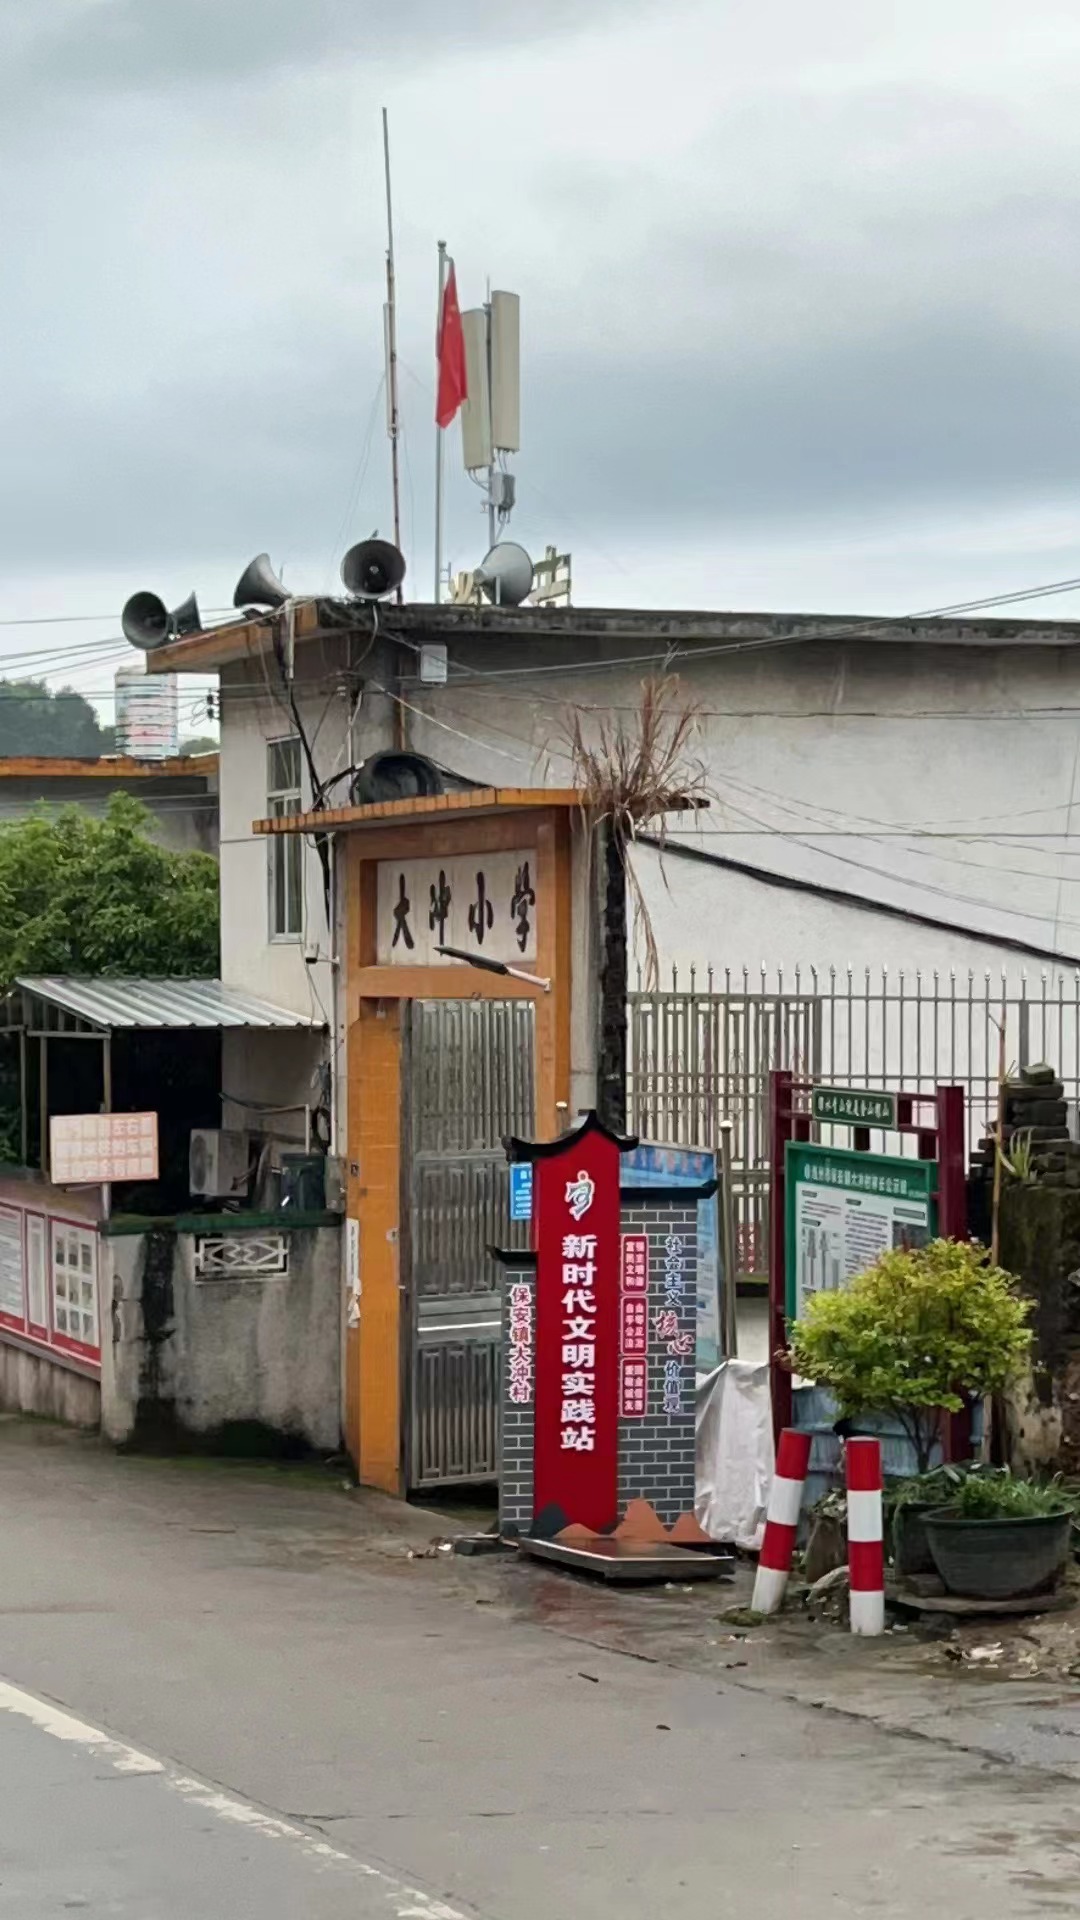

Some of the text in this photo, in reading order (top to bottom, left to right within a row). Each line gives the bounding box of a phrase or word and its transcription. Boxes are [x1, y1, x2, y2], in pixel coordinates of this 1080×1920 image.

[510, 1284, 532, 1403] 保安镇大冲村
[561, 1234, 597, 1451] 新时代文明实践站
